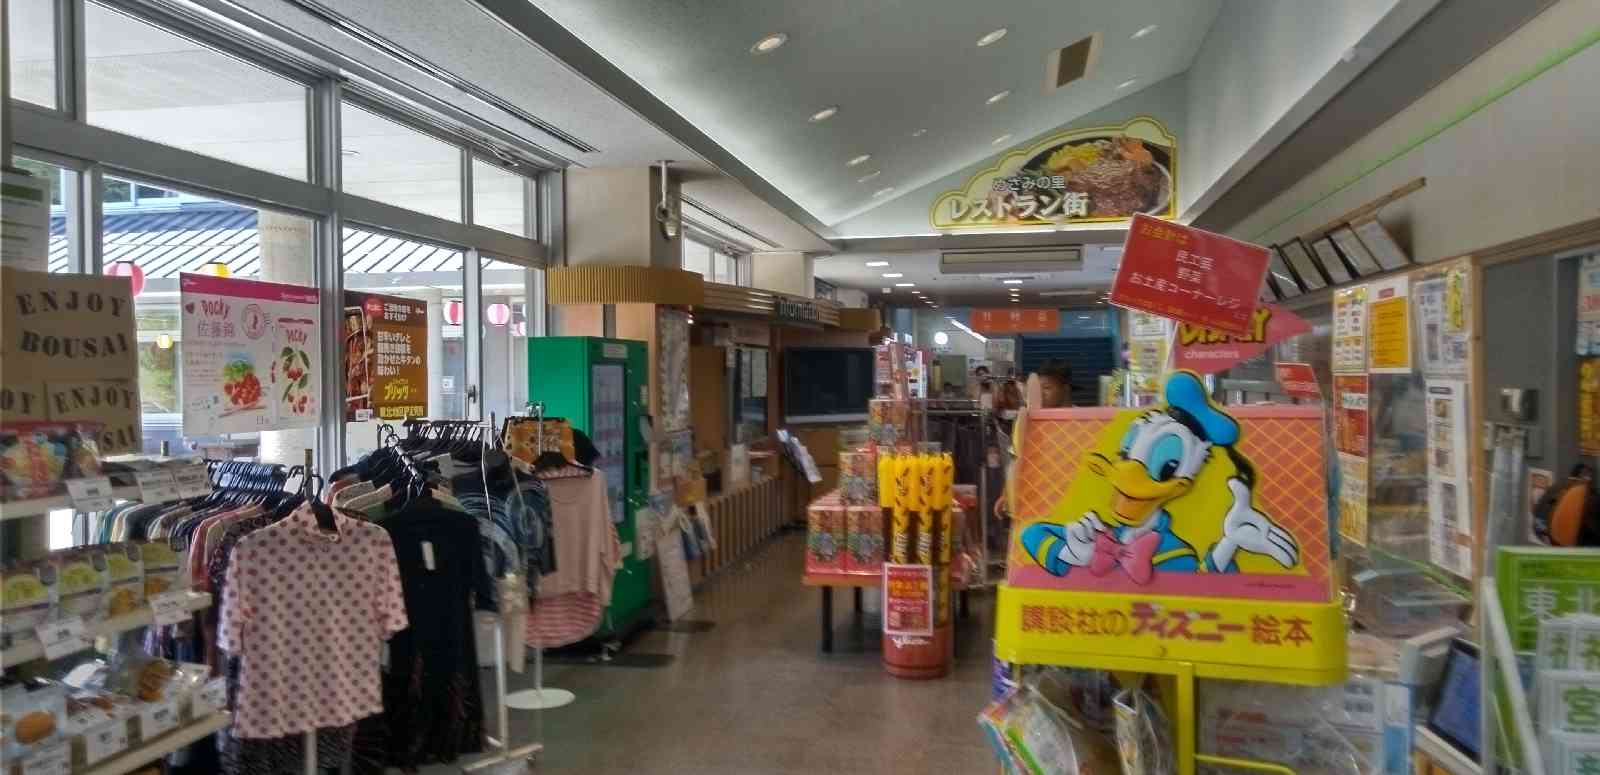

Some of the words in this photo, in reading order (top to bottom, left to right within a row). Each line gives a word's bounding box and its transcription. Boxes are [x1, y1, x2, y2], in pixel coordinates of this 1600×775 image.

[992, 174, 1066, 192] めざみの里
[950, 191, 1089, 219] レストラン街
[1176, 266, 1202, 283] 野菜
[16, 289, 126, 317] ENJOY
[1128, 271, 1242, 310] お土産コーナーレジ
[20, 331, 129, 359] BOUSAI
[1183, 349, 1241, 360] characters
[53, 384, 136, 415] ENJOY
[1021, 601, 1313, 648] 講談社のディズニー絵本
